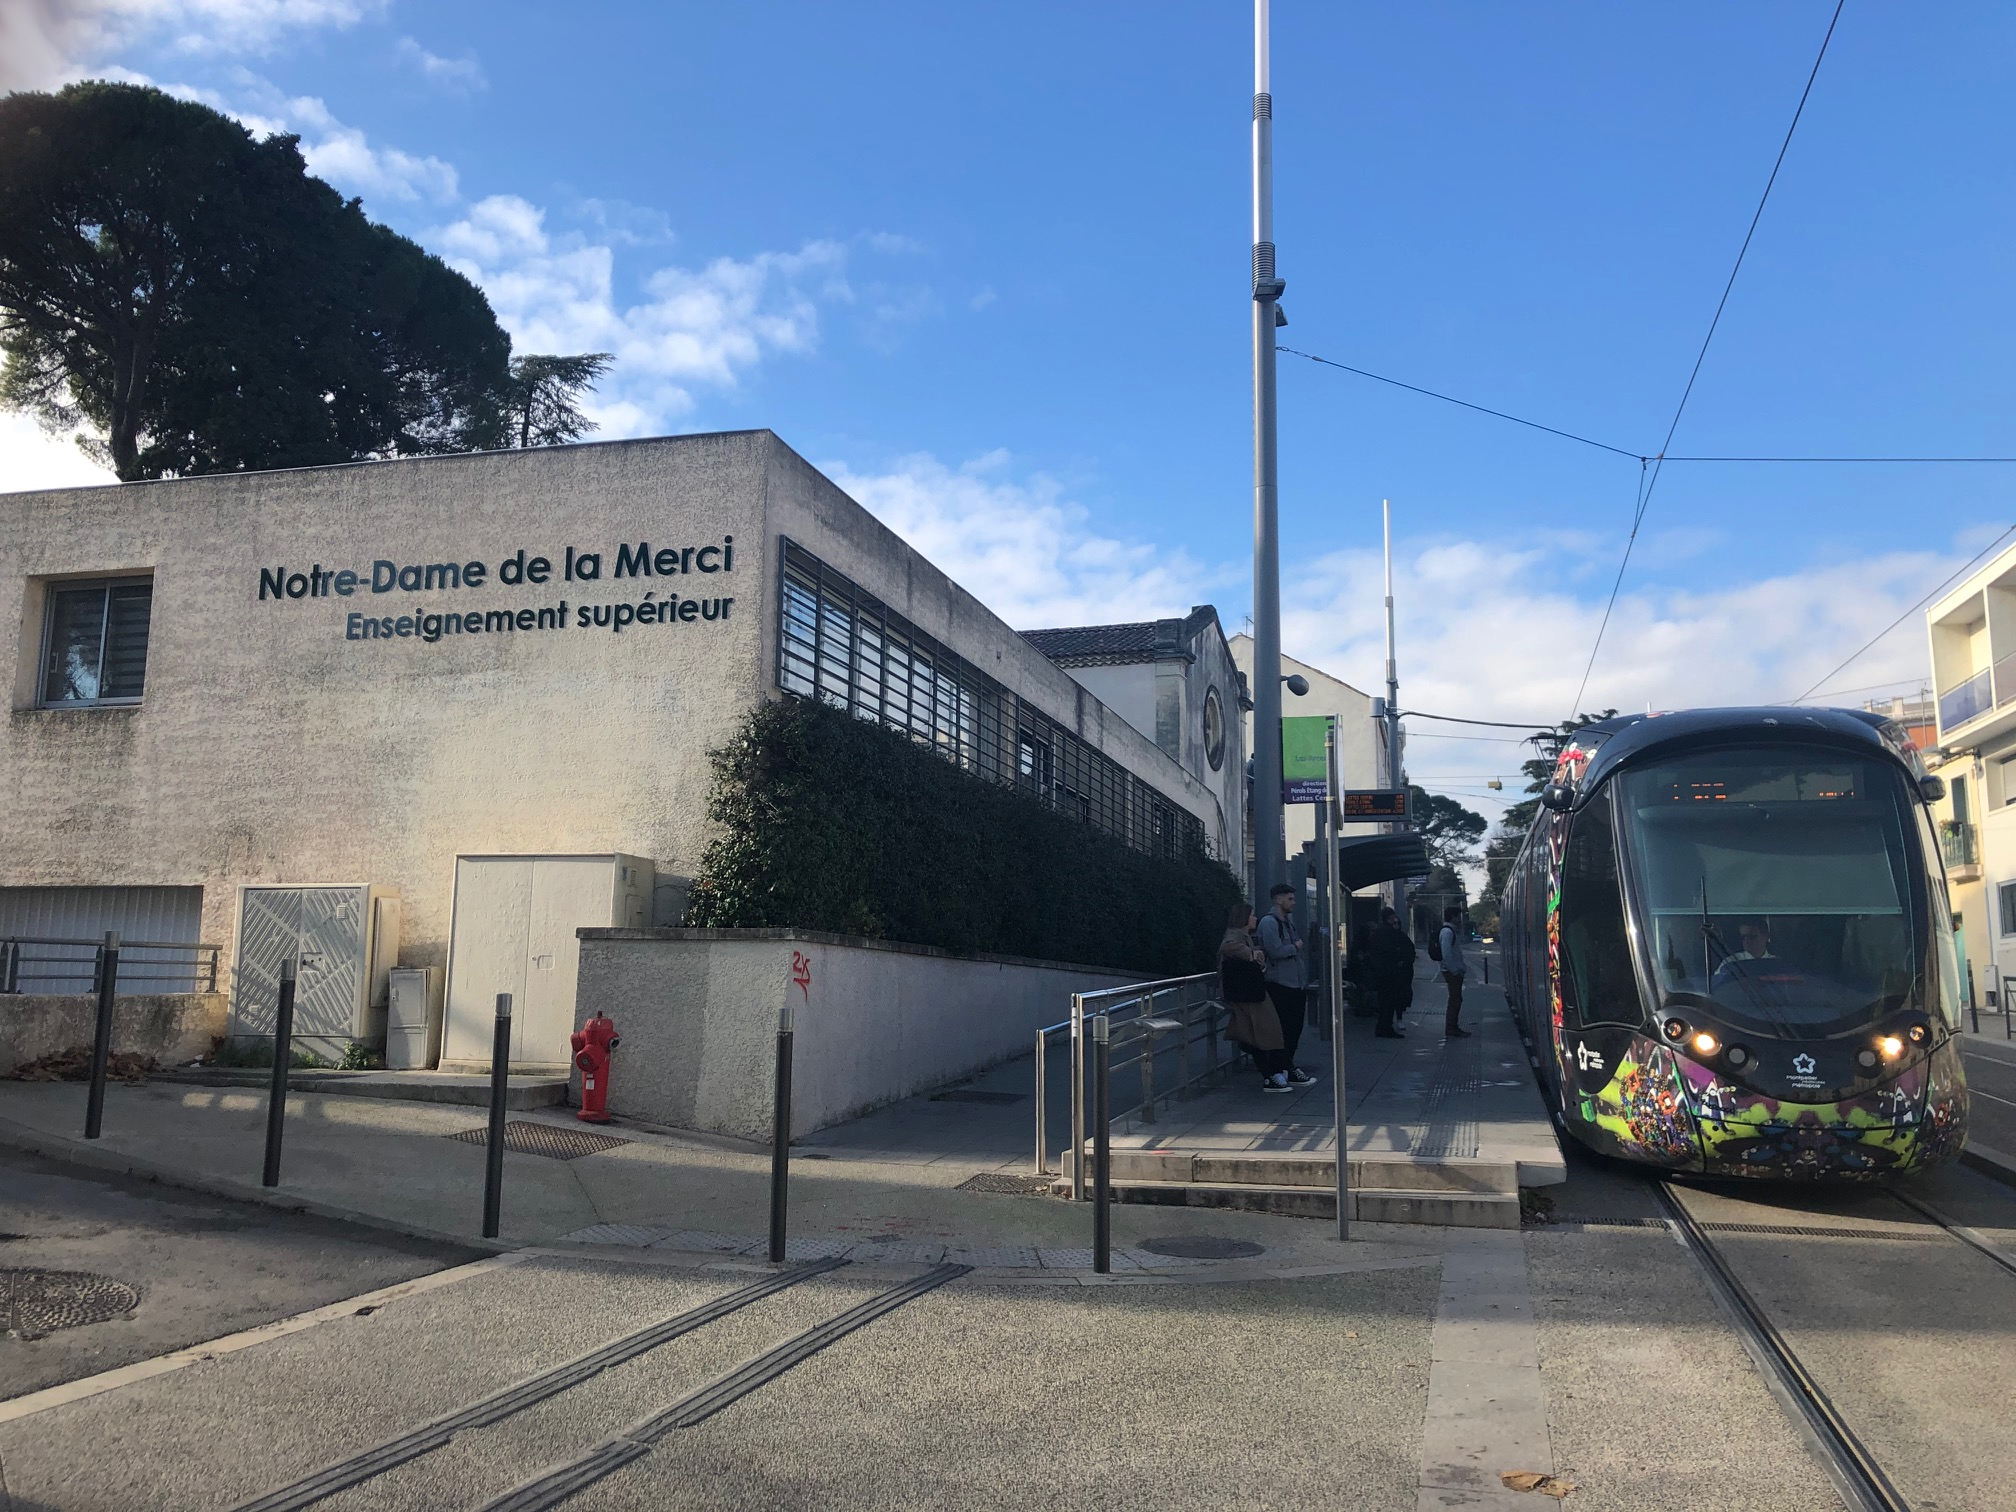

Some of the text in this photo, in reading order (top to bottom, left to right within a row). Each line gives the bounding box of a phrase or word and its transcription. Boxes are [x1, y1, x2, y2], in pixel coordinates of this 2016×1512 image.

[259, 535, 733, 600] Notre-Dame de la Merci
[346, 592, 733, 643] Enseignement supérieur
